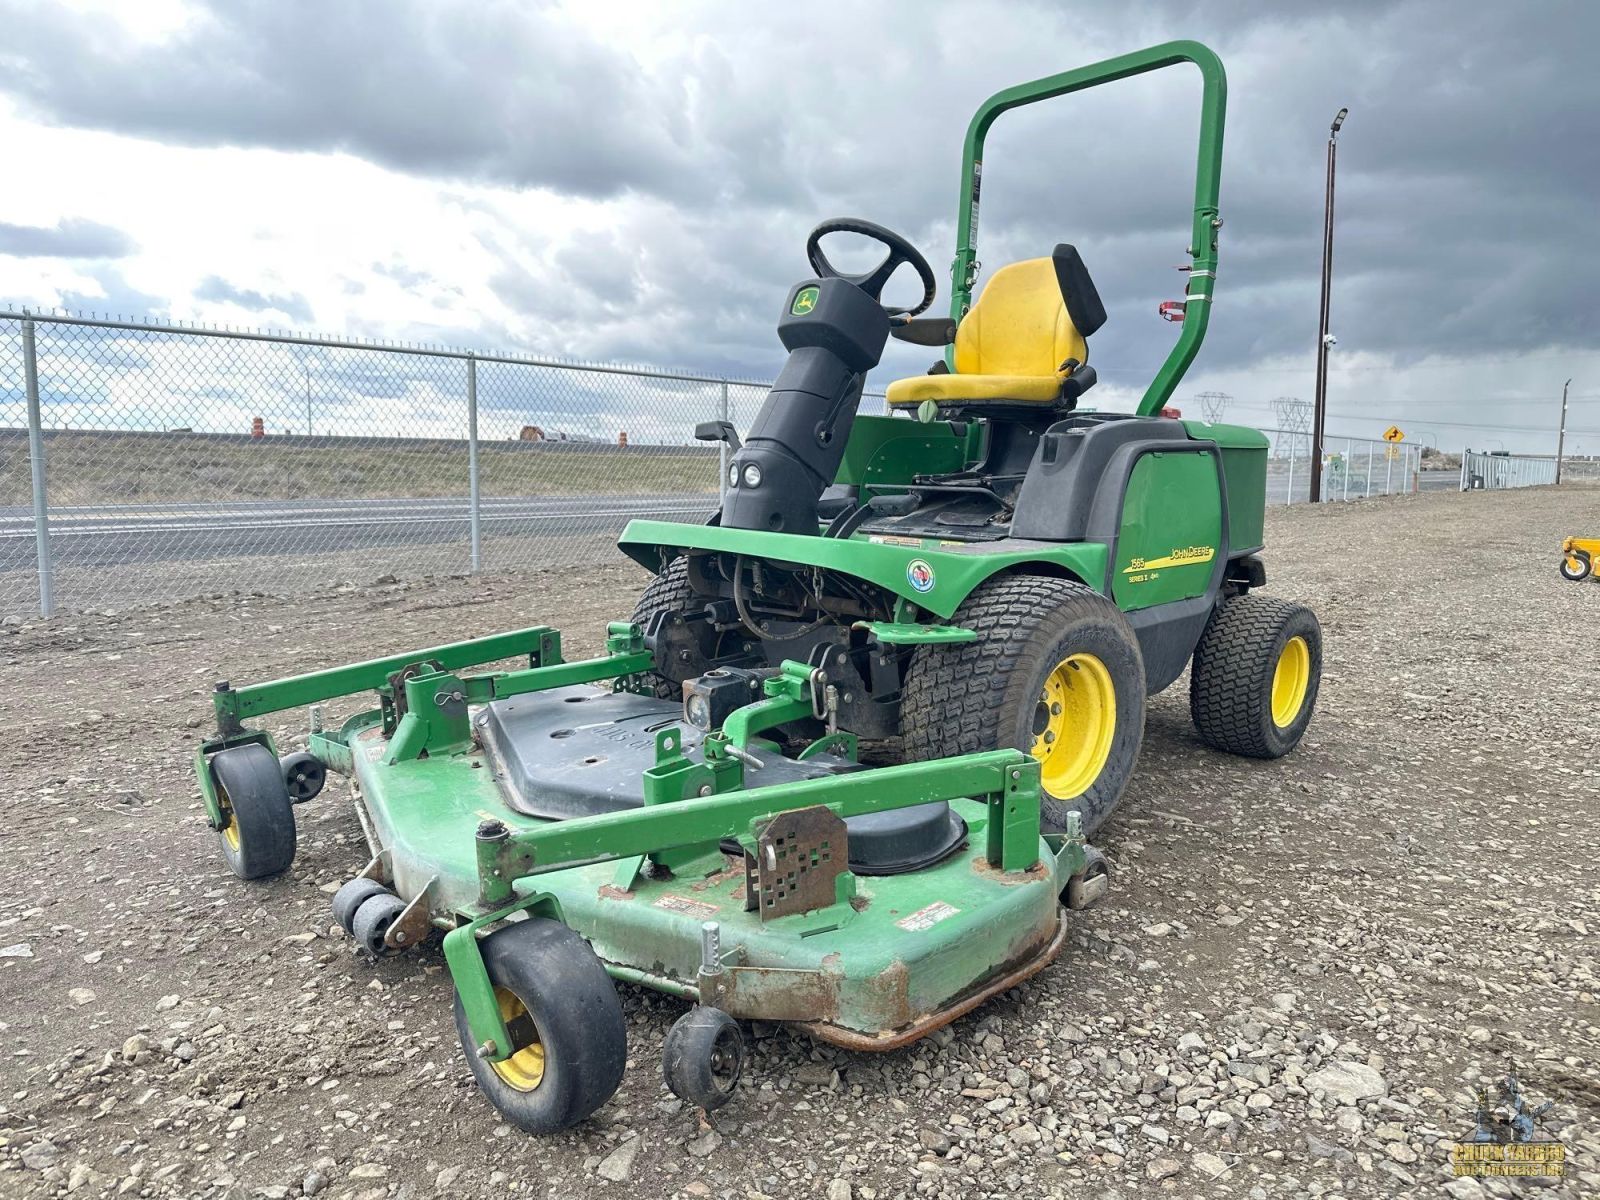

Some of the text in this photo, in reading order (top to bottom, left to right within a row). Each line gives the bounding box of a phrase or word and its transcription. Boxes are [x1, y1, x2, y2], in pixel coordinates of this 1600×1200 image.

[1170, 546, 1210, 560] JOHN DEERE
[1131, 558, 1145, 570] 1565
[1129, 575, 1144, 583] SERIES
